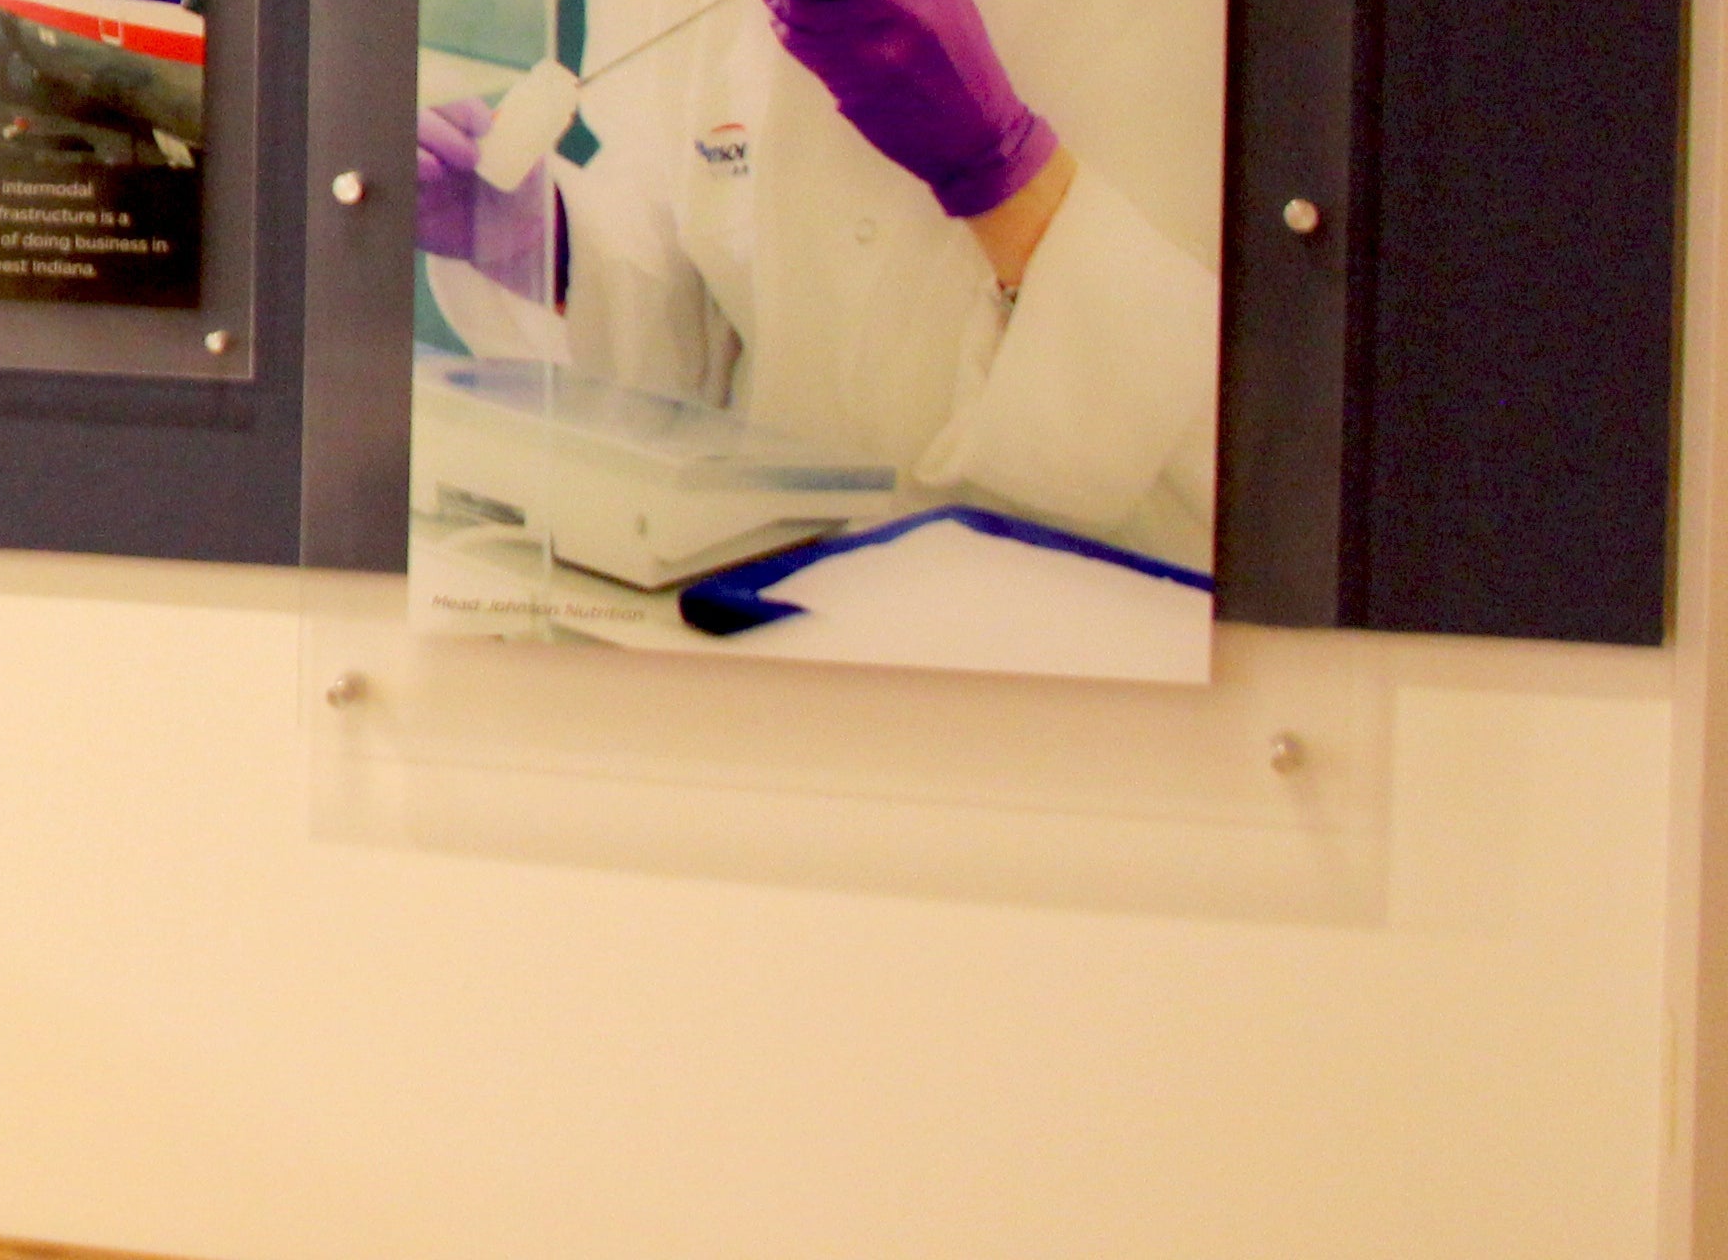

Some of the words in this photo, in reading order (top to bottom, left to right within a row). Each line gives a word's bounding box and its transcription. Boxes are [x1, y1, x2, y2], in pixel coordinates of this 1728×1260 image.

[1, 181, 95, 199] intermodal
[99, 209, 114, 226] is
[118, 213, 130, 227] a
[0, 231, 20, 247] of
[21, 233, 73, 252] doing
[74, 234, 149, 254] business
[151, 237, 170, 253] in
